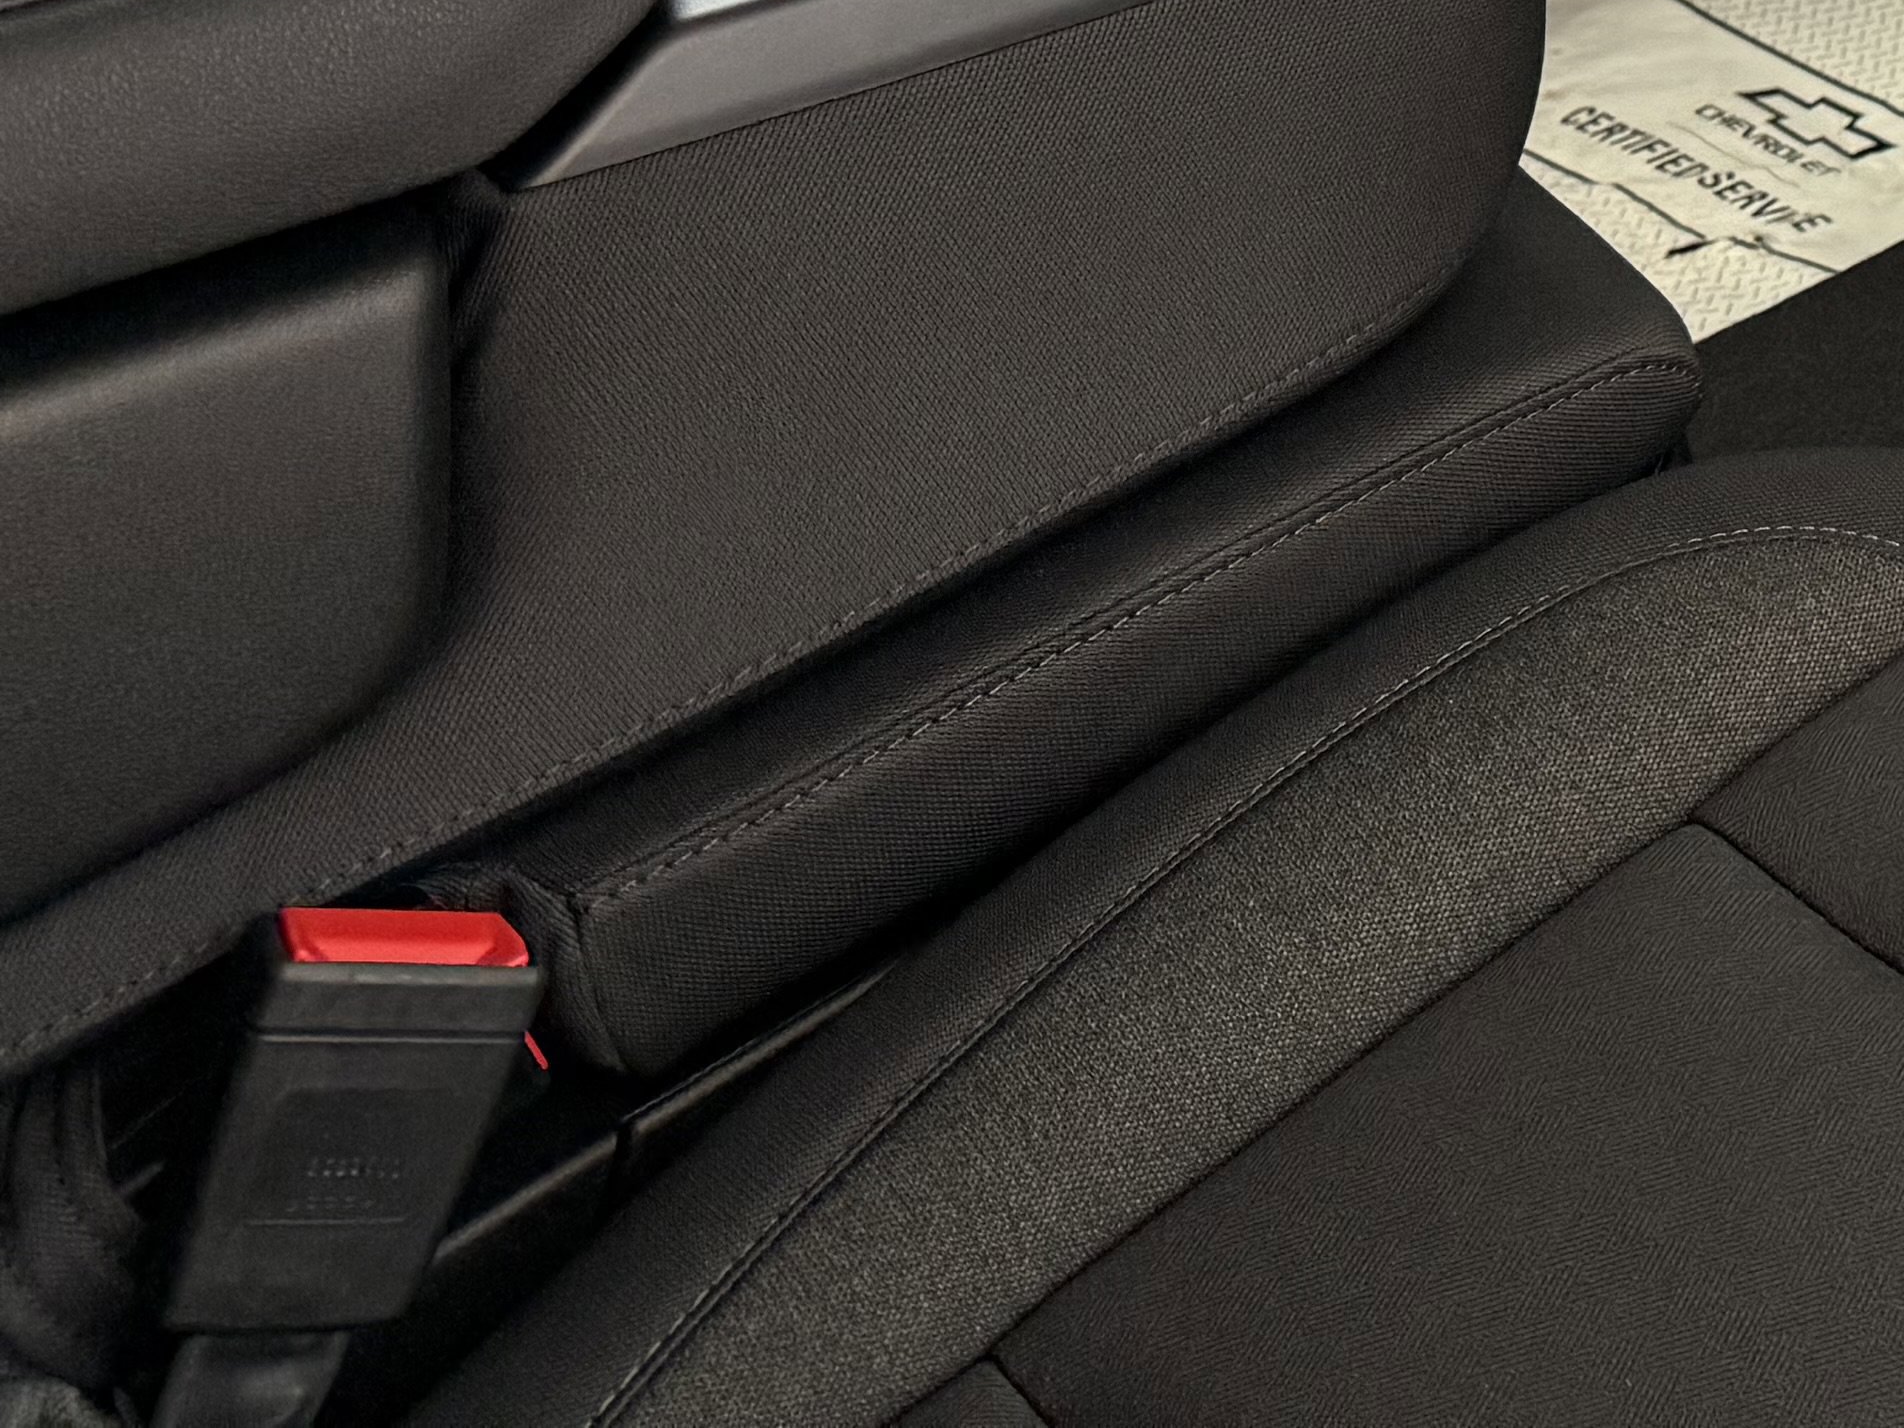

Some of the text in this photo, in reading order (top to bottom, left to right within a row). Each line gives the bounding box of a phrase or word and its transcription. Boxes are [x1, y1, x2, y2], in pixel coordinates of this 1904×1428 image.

[1559, 105, 1833, 232] CERTIFIED SERVIE
[1694, 103, 1841, 176] CHEVROLET
